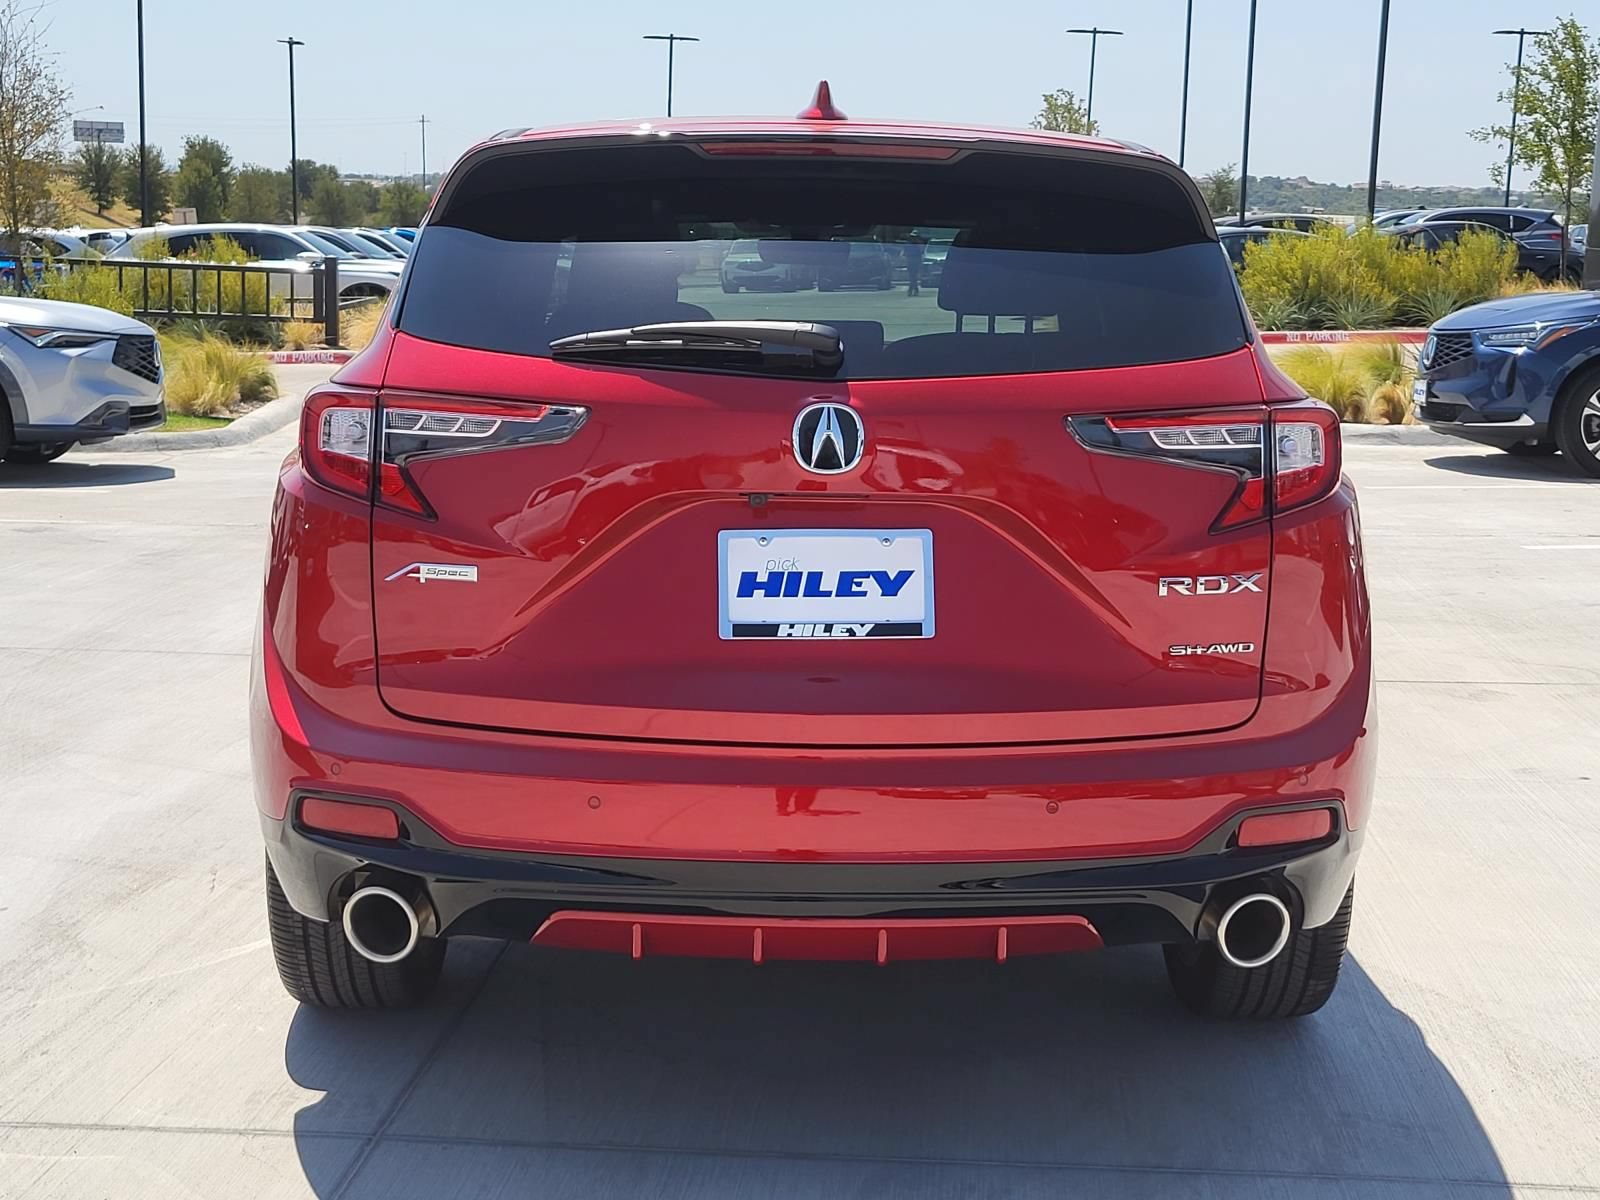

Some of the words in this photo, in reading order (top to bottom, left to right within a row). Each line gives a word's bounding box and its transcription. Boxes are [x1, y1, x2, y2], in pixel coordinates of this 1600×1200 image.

[1286, 332, 1301, 342] NO
[1306, 331, 1350, 342] PARKING
[273, 352, 288, 362] NO
[292, 352, 335, 362] PARKING
[765, 557, 800, 574] pick
[736, 570, 915, 598] HILEY
[1158, 573, 1264, 597] RDX
[777, 623, 876, 638] HILEY
[1169, 642, 1255, 656] SH-AWD
